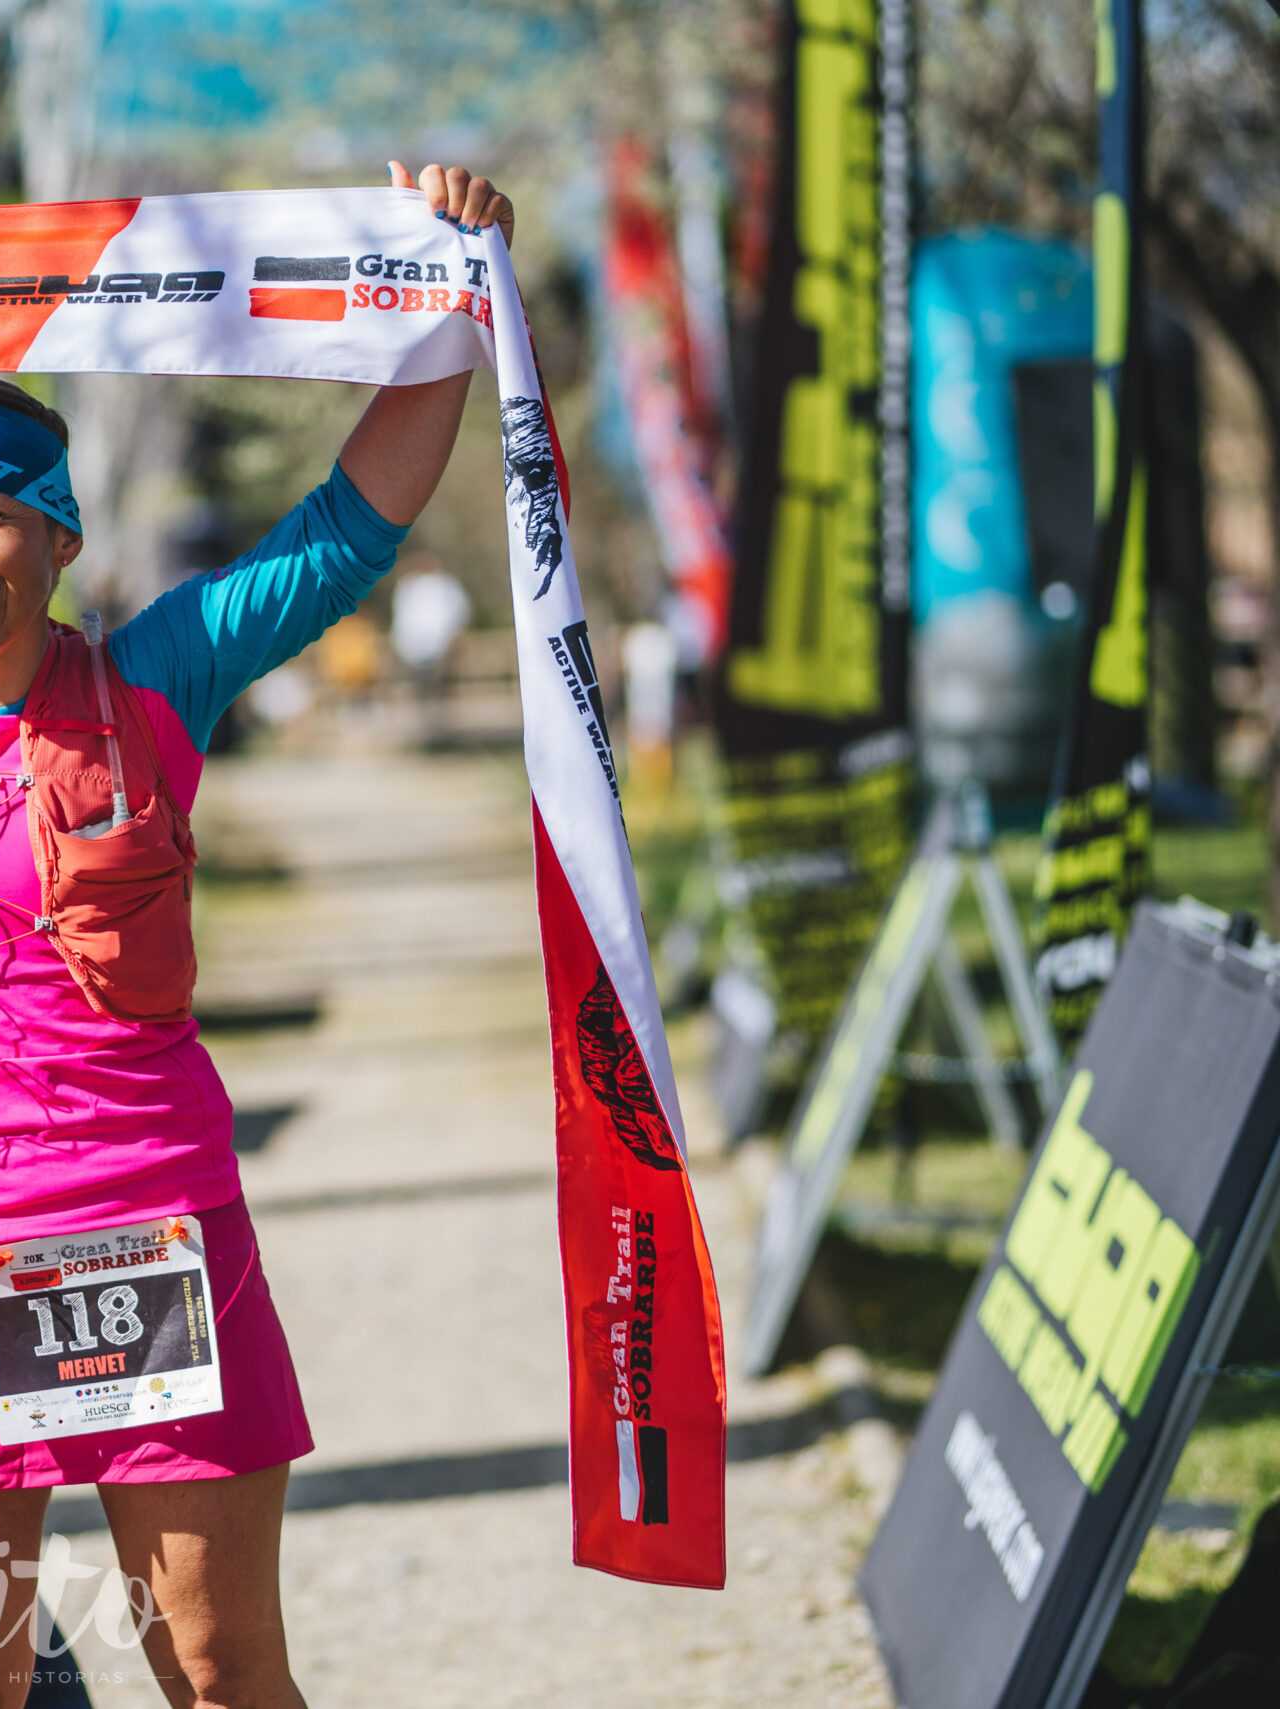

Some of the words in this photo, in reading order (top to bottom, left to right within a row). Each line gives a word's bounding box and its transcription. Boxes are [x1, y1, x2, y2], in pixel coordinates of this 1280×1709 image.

[355, 254, 449, 282] Gran
[64, 294, 143, 304] WEAR
[351, 283, 494, 331] SOBRAR
[547, 636, 590, 715] ACTIVE
[61, 1241, 112, 1259] Gran
[116, 1230, 166, 1252] Trail
[63, 1247, 169, 1276] SOBRARBE
[606, 1206, 632, 1305] Trail
[28, 1284, 144, 1357] 118
[630, 1211, 658, 1421] SOBRARBE
[57, 1352, 127, 1382] MERVET
[610, 1319, 632, 1416] Gran
